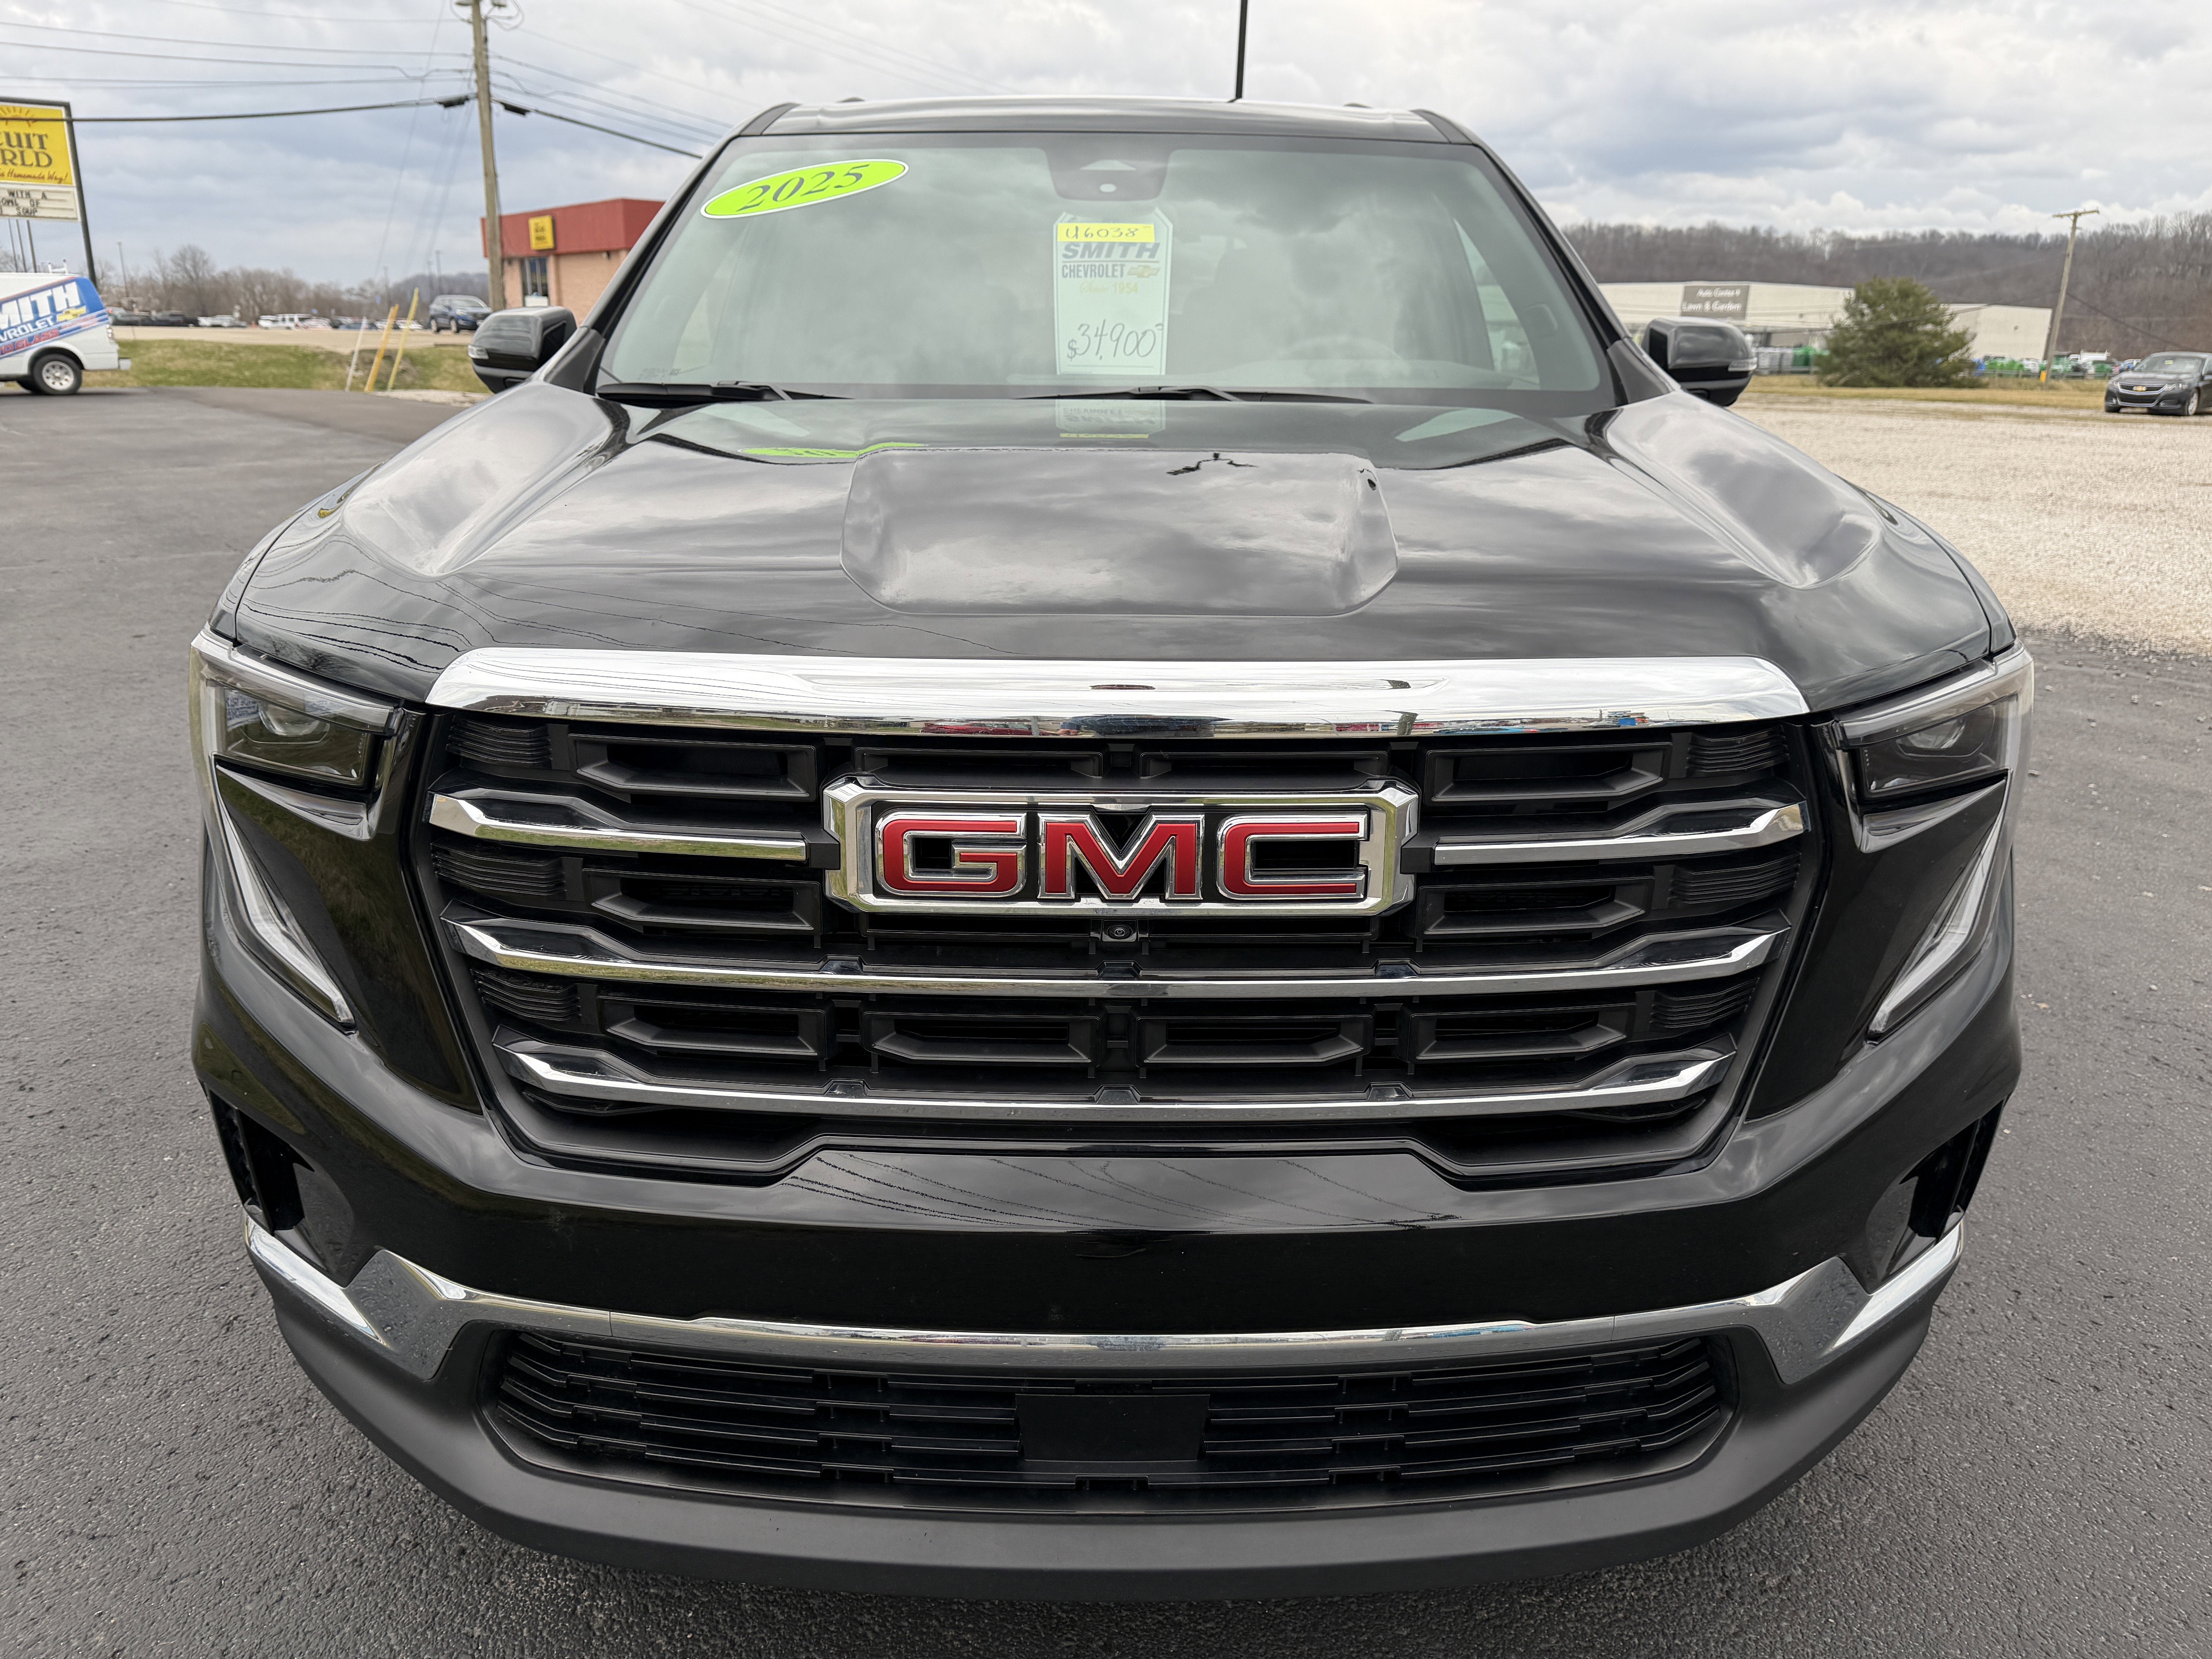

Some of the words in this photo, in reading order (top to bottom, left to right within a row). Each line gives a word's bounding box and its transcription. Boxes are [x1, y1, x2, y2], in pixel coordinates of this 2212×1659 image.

[7, 189, 31, 199] WITH
[41, 191, 47, 200] A
[736, 164, 870, 212] 2025
[0, 197, 19, 206] OWL
[16, 206, 38, 215] SOUP
[1061, 242, 1160, 259] SMITH
[1061, 264, 1125, 278] CHEVROLET
[15, 329, 59, 350] GLASS
[875, 811, 1368, 901] GMC
